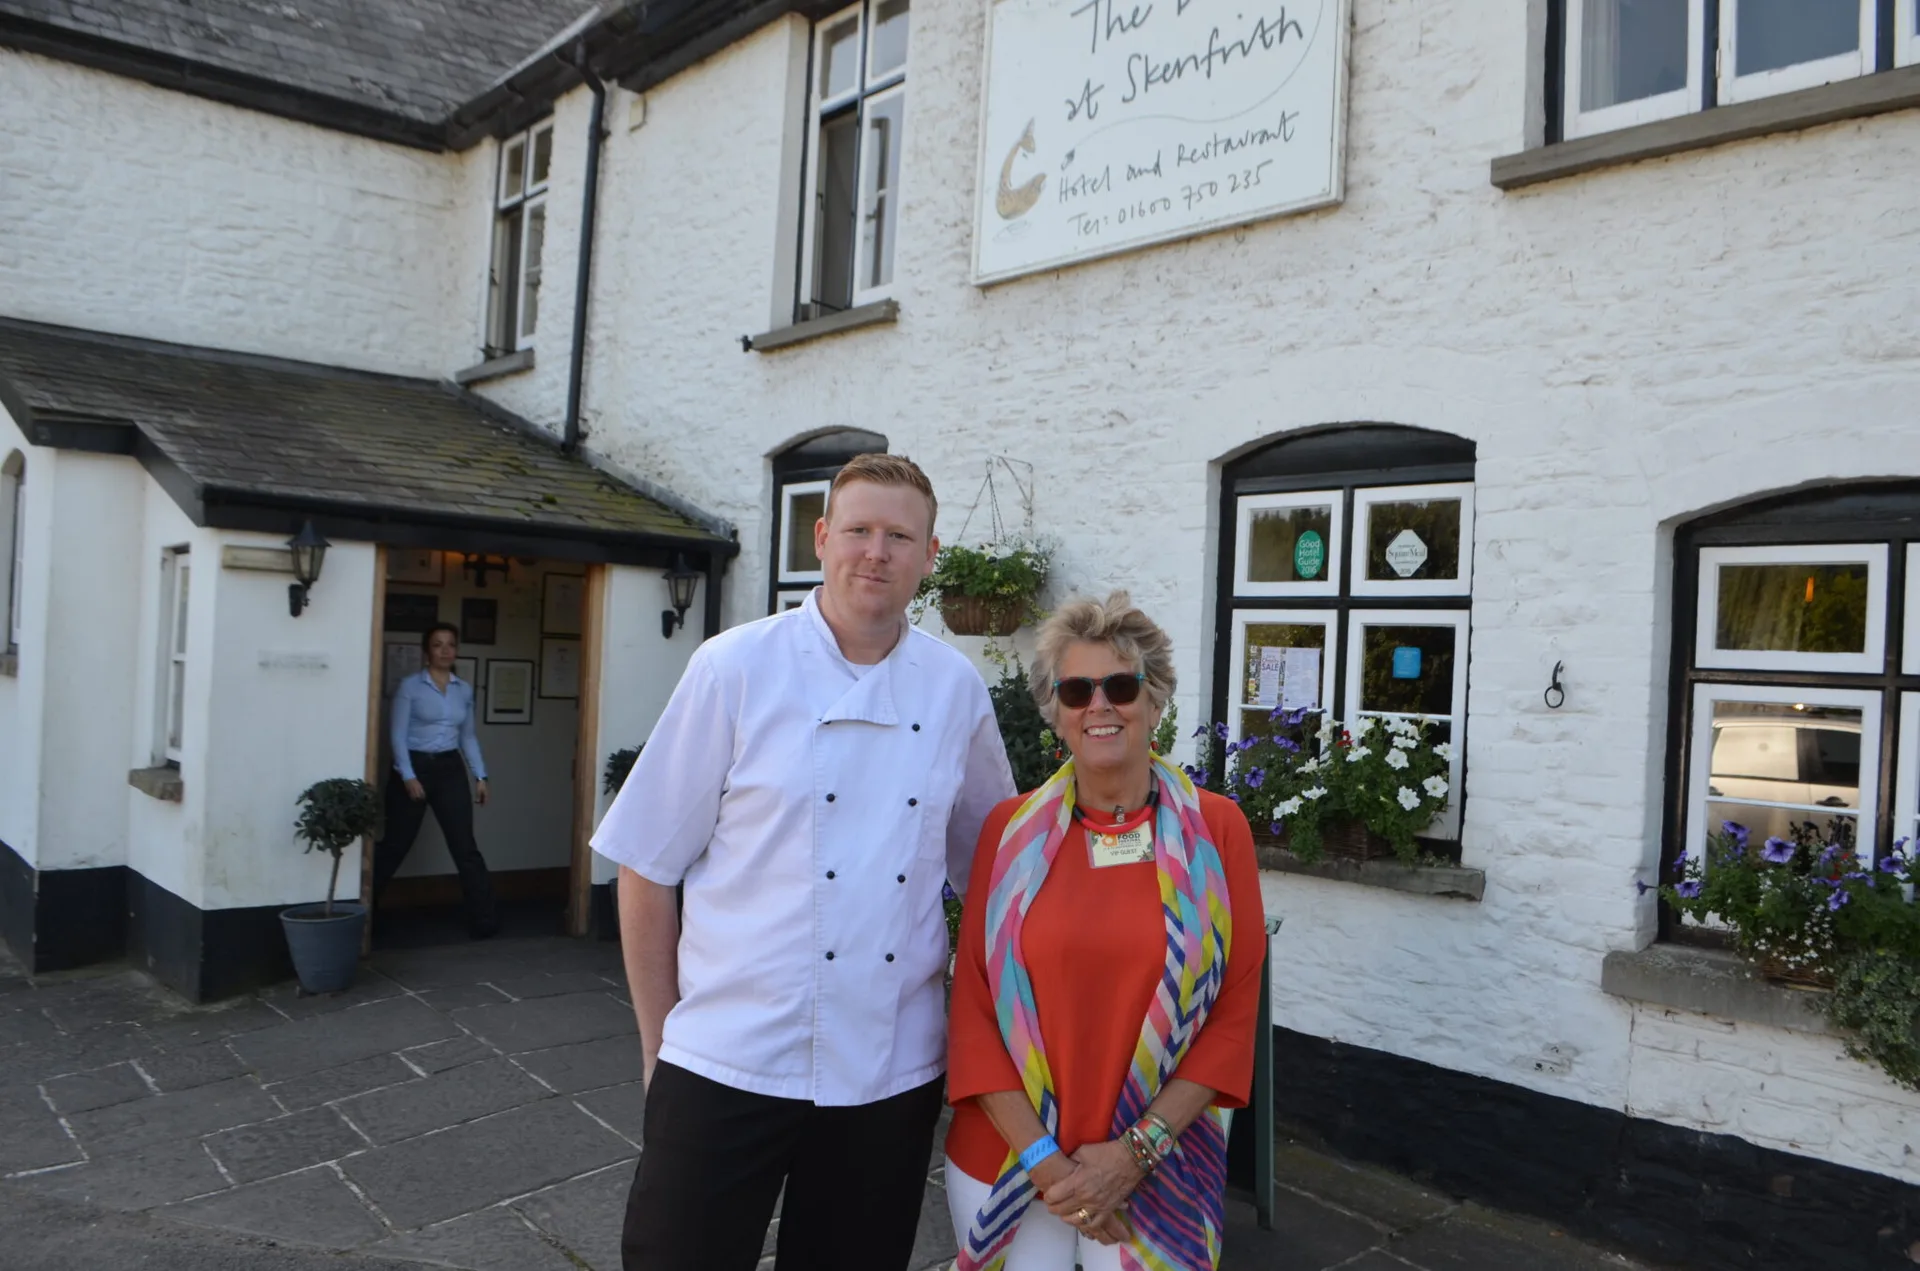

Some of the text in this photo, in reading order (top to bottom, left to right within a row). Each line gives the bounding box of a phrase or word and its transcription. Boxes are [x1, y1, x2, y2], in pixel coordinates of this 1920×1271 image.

[1070, 0, 1152, 53] The
[1065, 5, 1303, 121] at Skenfrith
[1059, 110, 1300, 204] Hotel and Restaurant
[1117, 196, 1171, 224] 01600
[1180, 181, 1218, 211] 750
[1227, 158, 1273, 194] 235
[1299, 539, 1321, 549] Good
[1299, 548, 1320, 558] Hotel
[1298, 557, 1320, 566] Guide
[1261, 663, 1279, 671] SALE
[1117, 832, 1141, 840] FOOD
